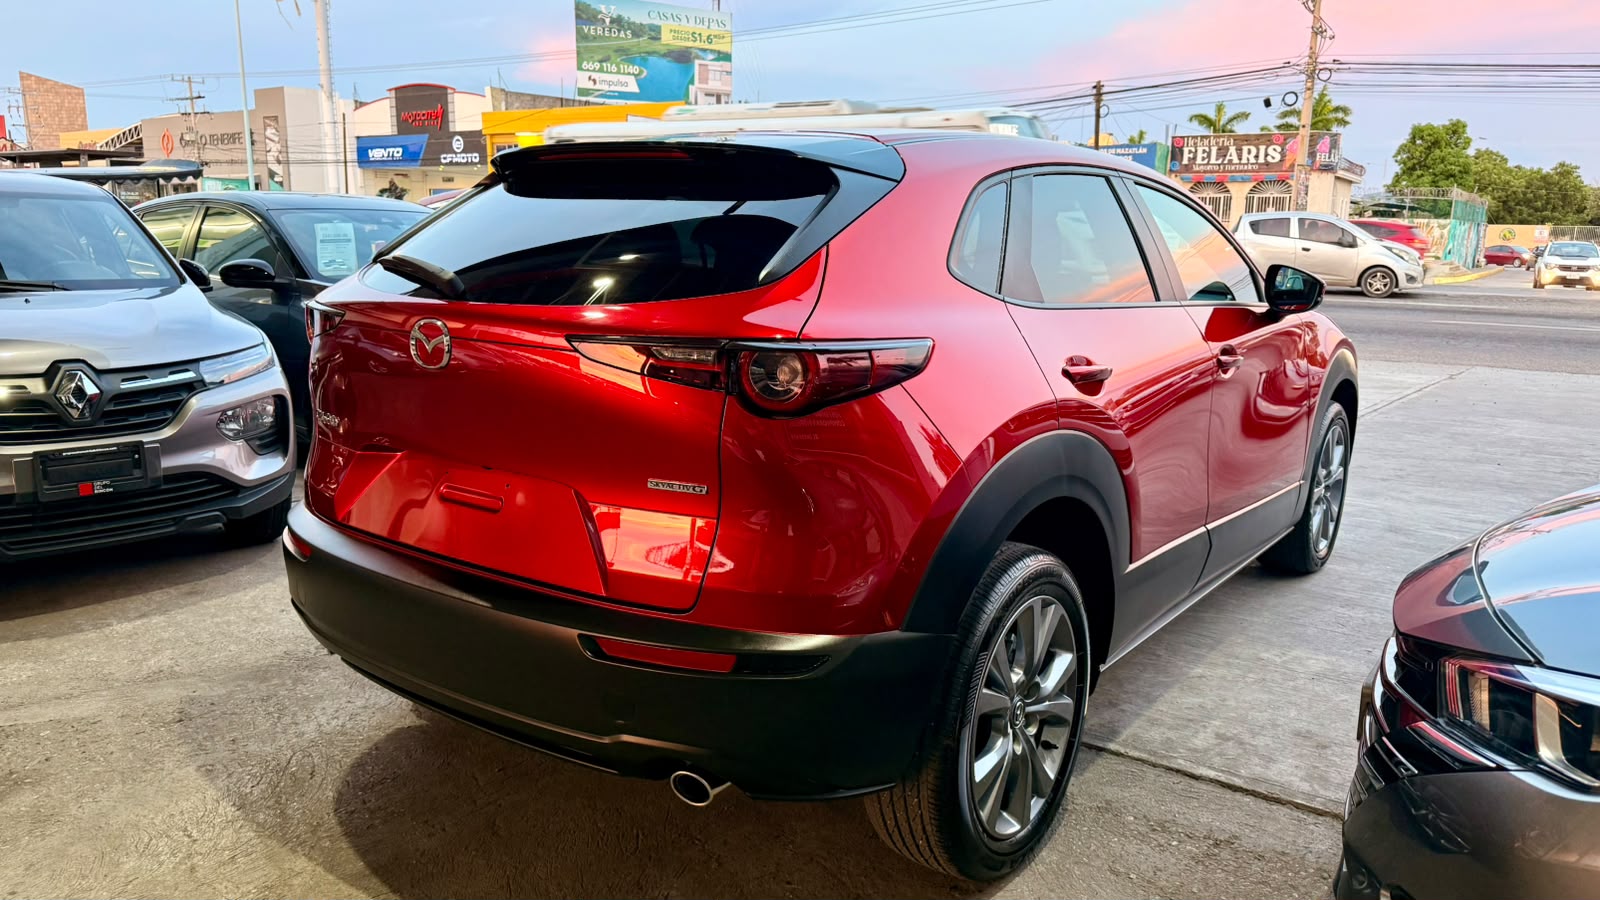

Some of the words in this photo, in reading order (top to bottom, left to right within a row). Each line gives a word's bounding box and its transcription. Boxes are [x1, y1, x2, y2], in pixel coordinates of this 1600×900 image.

[648, 10, 682, 23] CASAS
[685, 14, 692, 24] Y
[694, 16, 727, 29] DEPAS
[583, 25, 632, 39] VEREDAS
[582, 61, 600, 71] 669
[602, 63, 617, 73] 116
[620, 64, 640, 75] 1140
[598, 76, 629, 89] impulsa
[368, 147, 403, 158] VENTO
[440, 153, 480, 163] CFMOTO
[1182, 144, 1282, 165] FELARIS
